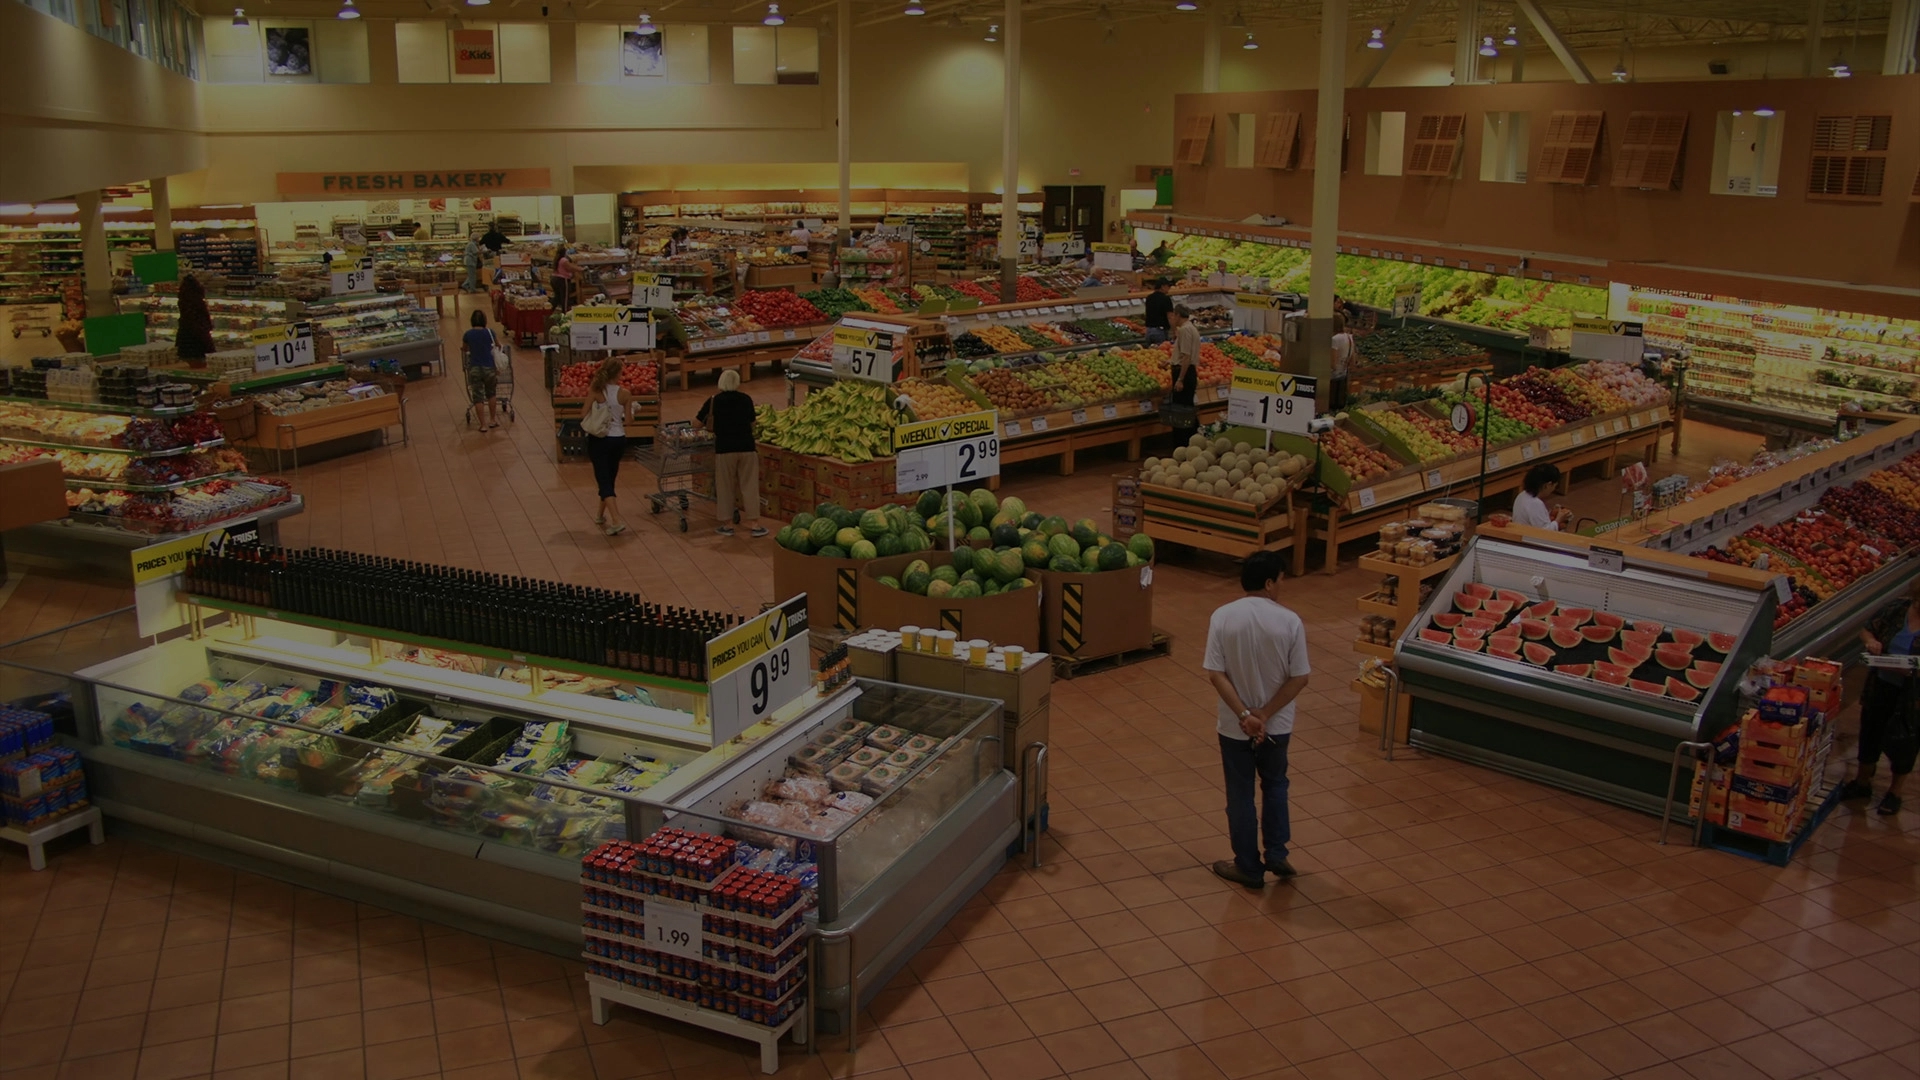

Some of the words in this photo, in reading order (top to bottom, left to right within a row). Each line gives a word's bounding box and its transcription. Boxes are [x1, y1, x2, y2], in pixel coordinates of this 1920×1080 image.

[323, 176, 403, 190] FRESH
[413, 172, 507, 188] BAKERY
[348, 274, 355, 290] 5
[356, 272, 365, 281] 99
[644, 287, 648, 304] 1
[599, 325, 607, 345] 1
[614, 325, 628, 336] 47
[258, 354, 270, 362] from
[271, 343, 294, 365] 10
[295, 340, 306, 352] 44
[852, 350, 875, 376] 57
[1234, 376, 1253, 384] PRICES
[1259, 396, 1269, 423] 1
[1276, 398, 1293, 415] 99
[901, 426, 937, 444] WEEKLY
[954, 420, 990, 435] SPECIAL
[1365, 418, 1388, 437] organic
[959, 444, 976, 478] 2
[979, 439, 997, 458] 99
[1595, 517, 1629, 533] organic
[137, 556, 167, 572] PRICES
[168, 552, 184, 563] YOU
[712, 647, 736, 669] PRICES
[737, 642, 750, 655] YOU
[751, 632, 763, 648] CAN
[751, 662, 768, 715] 9
[771, 648, 790, 682] 99
[657, 926, 690, 947] 1.99
